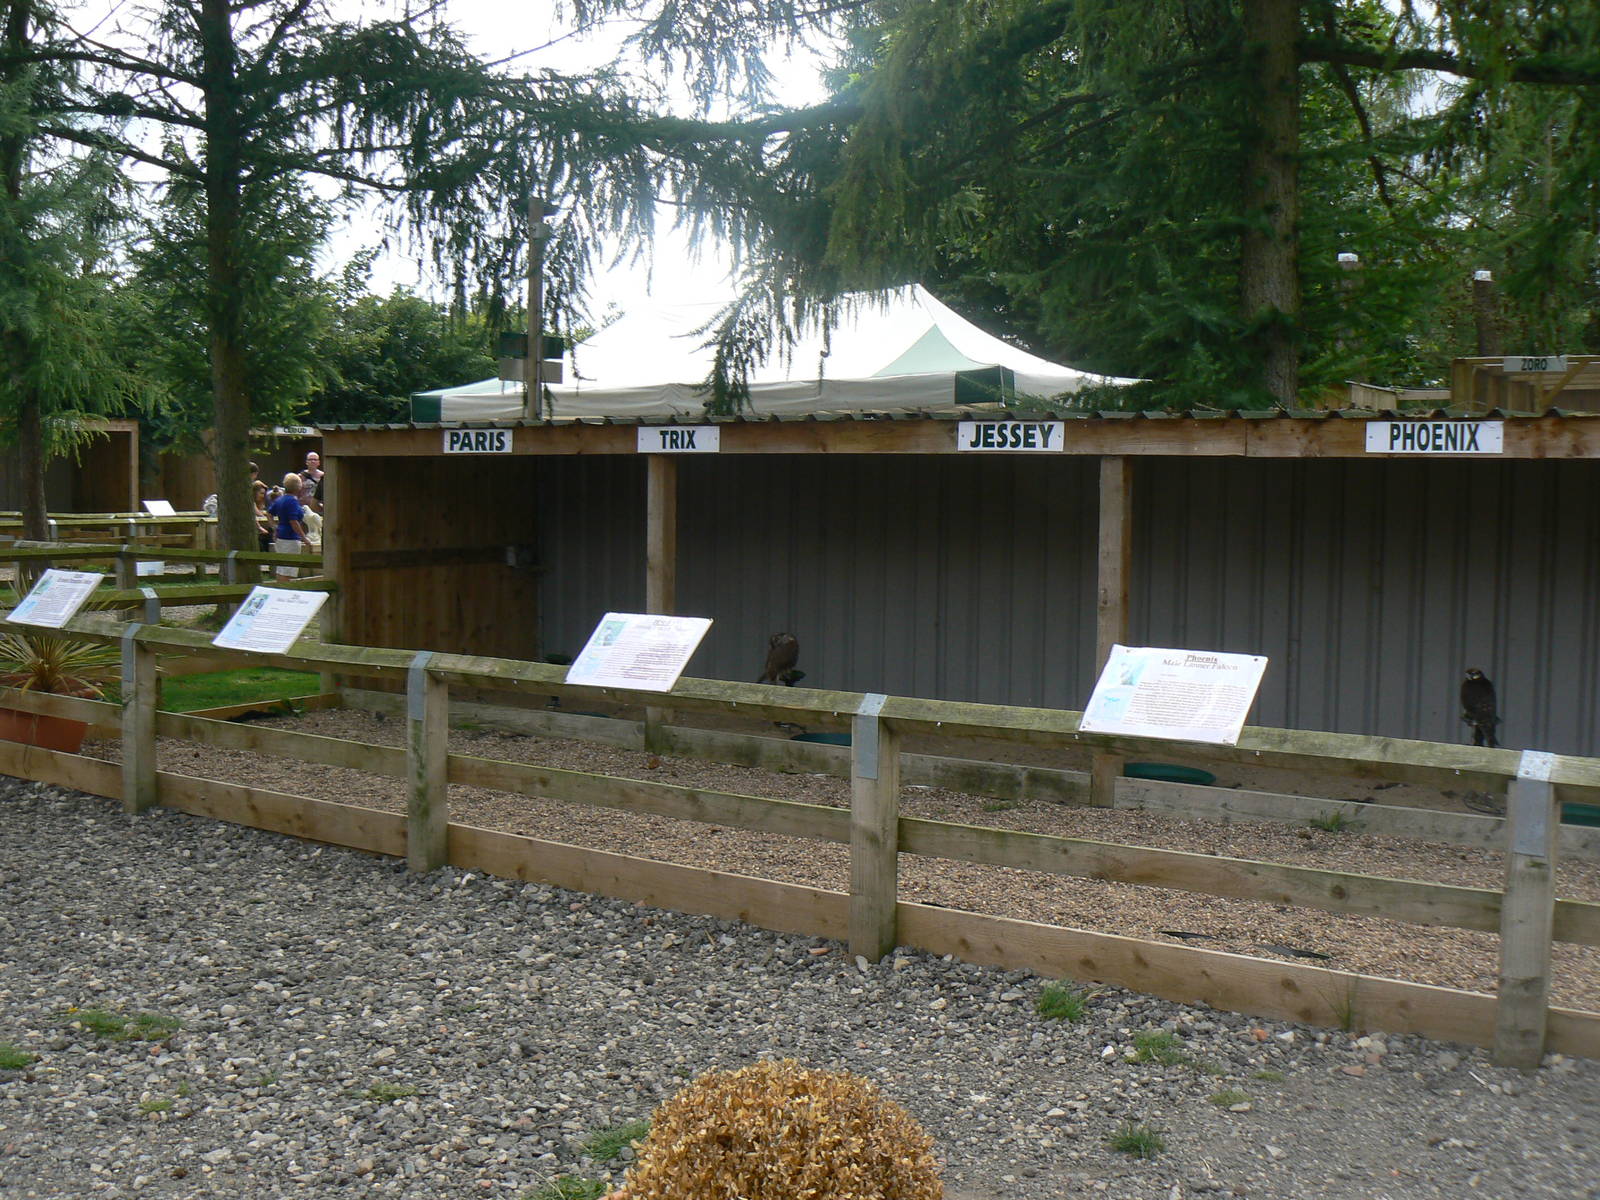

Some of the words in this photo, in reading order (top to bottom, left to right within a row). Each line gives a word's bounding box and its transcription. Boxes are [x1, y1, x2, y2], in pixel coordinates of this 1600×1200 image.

[1521, 358, 1548, 370] ZORO
[450, 431, 505, 451] PARIS
[659, 430, 696, 449] TRIX
[970, 424, 1054, 448] JESSEY
[1389, 423, 1480, 451] PHOENIX
